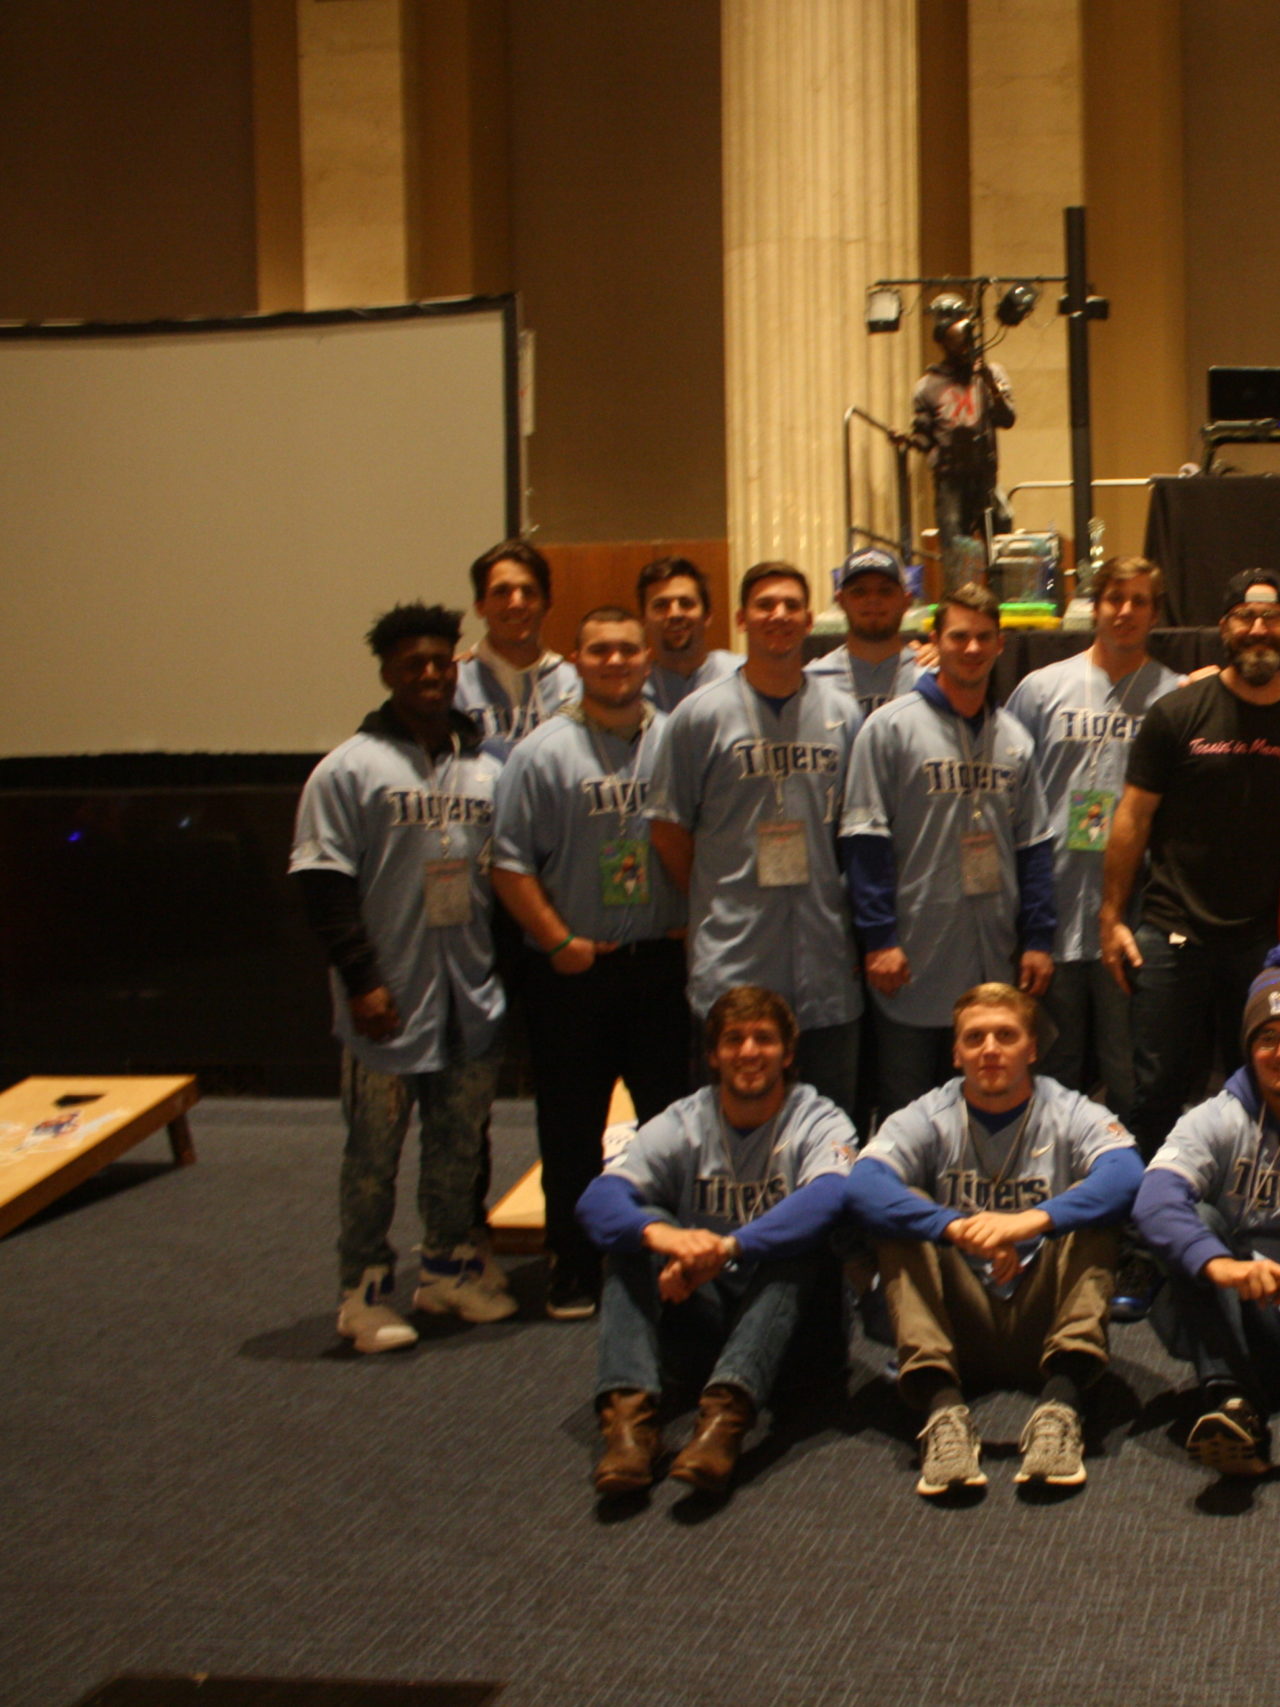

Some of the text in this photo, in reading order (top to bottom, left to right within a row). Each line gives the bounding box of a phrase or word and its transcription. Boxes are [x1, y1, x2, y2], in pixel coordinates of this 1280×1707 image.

[733, 739, 841, 779] Tigers
[922, 757, 1018, 796] Tigers
[387, 788, 494, 829] Tigers
[946, 1170, 1050, 1213] Tigers
